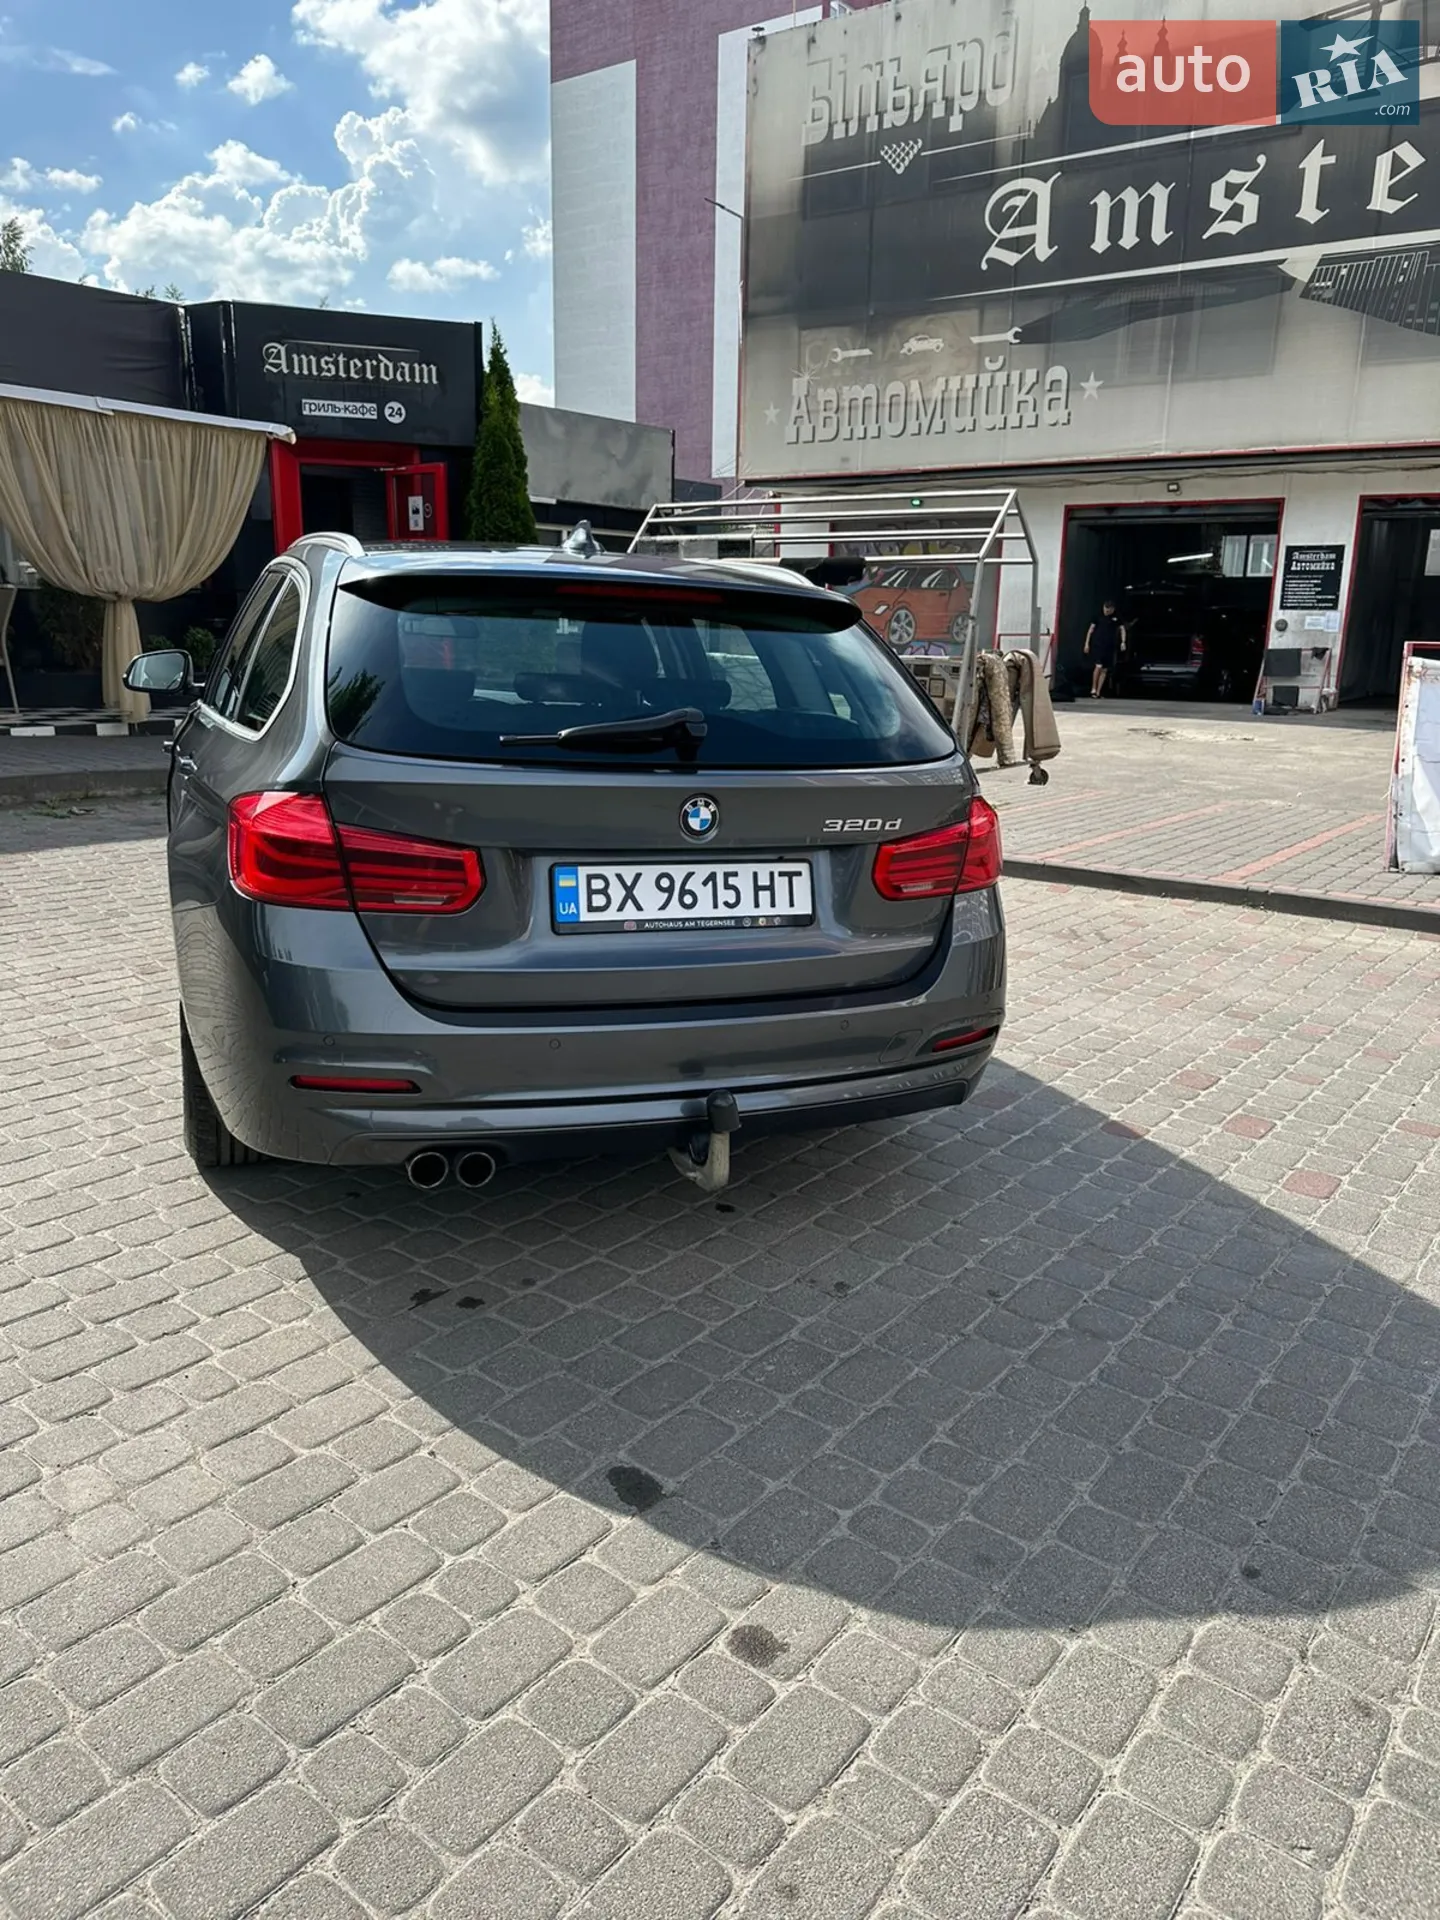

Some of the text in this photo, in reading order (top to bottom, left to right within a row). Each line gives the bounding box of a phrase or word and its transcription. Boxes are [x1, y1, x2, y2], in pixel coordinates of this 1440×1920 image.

[801, 14, 1019, 146] Більярд
[262, 342, 440, 385] Amsterdam
[388, 406, 403, 418] 24
[785, 355, 1072, 445] Автомийка
[822, 818, 903, 832] 320d
[586, 870, 803, 913] BX 9615 HT
[559, 903, 577, 916] UA
[644, 919, 736, 929] AUTOHAUS AM TEGERNSEE
